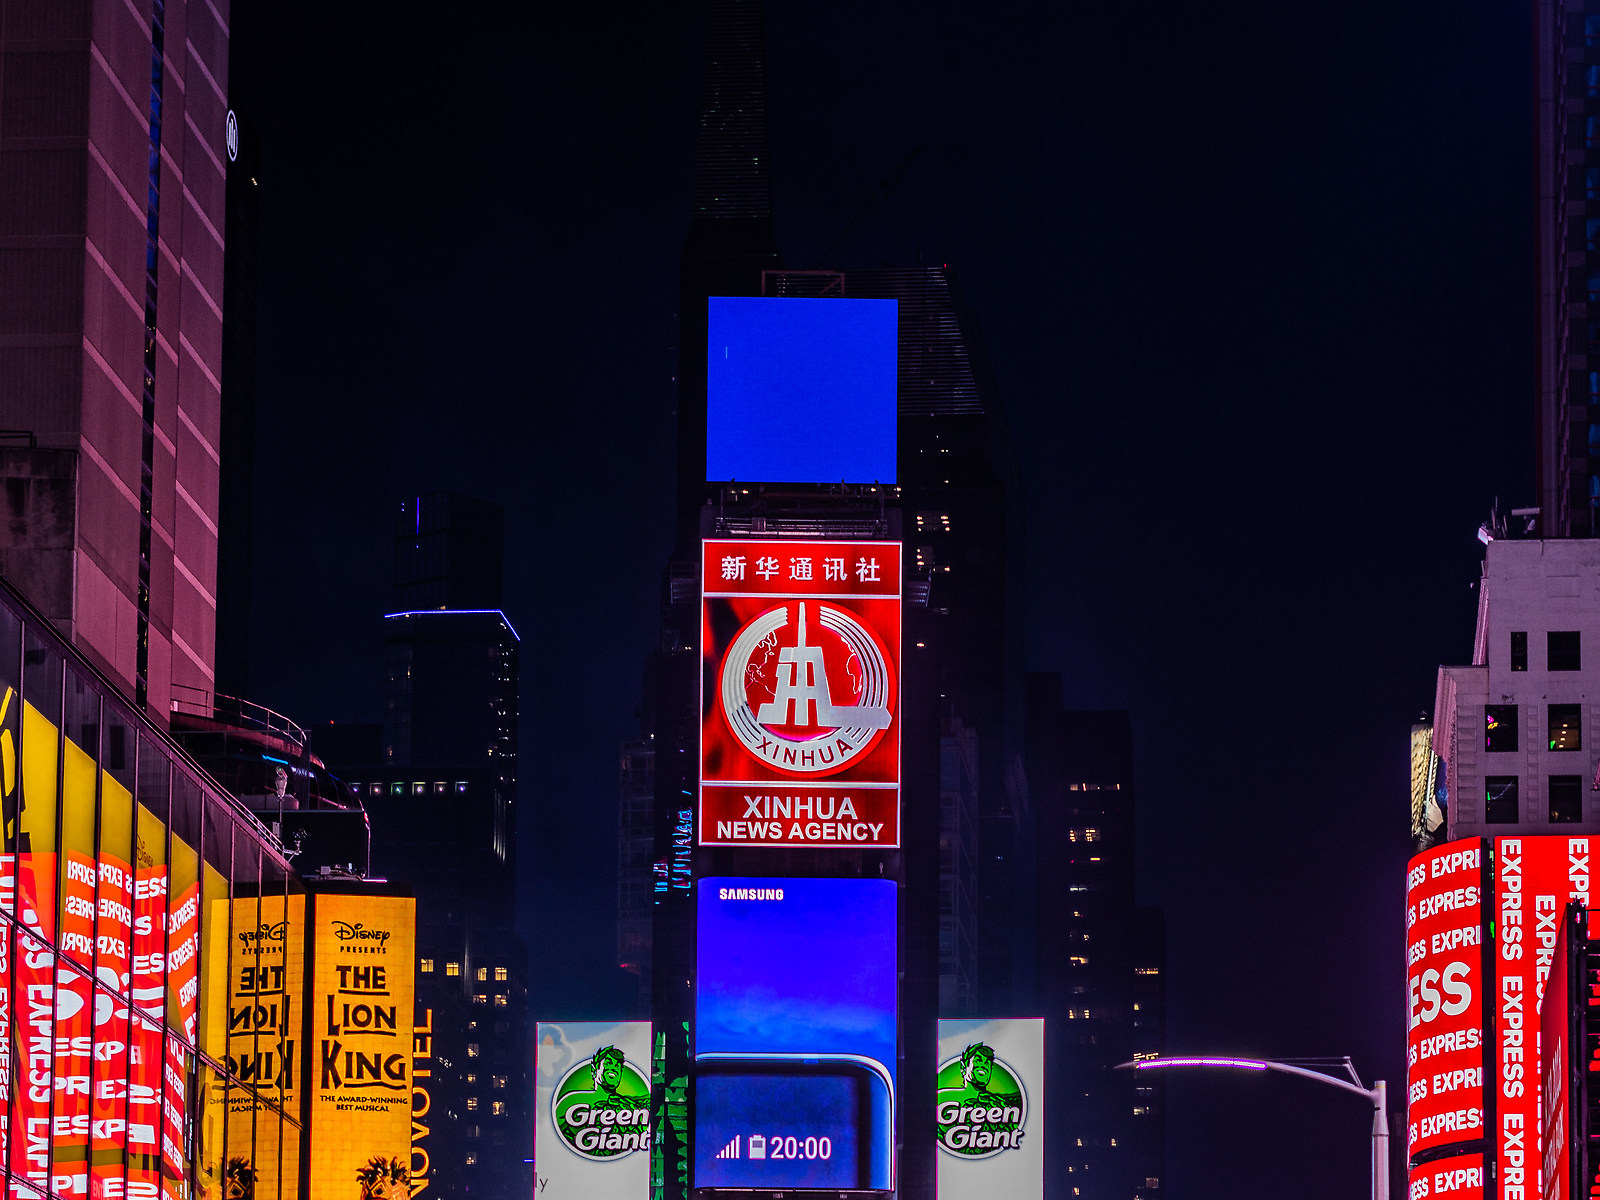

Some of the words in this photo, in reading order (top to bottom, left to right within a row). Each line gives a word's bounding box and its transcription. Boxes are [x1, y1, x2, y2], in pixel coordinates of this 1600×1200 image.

[721, 556, 881, 581] 新华通讯社
[756, 735, 853, 767] XINHUA
[743, 796, 858, 819] XINHUA
[717, 821, 783, 839] NEWS
[788, 823, 884, 841] AGENCY
[719, 888, 784, 900] SAMSUNG
[1501, 839, 1523, 960] EXPRESS
[340, 946, 387, 954] PRESENTS
[336, 965, 386, 990] THE
[327, 994, 397, 1037] LION
[1502, 976, 1524, 1098] EXPRESS
[320, 1039, 407, 1090] KING
[337, 1096, 408, 1105] AWARD-WINNING
[938, 1101, 1020, 1124] Green
[565, 1103, 649, 1126] Green
[575, 1126, 651, 1151] Giant
[770, 1136, 832, 1159] 20:00
[945, 1125, 1025, 1149] Giant
